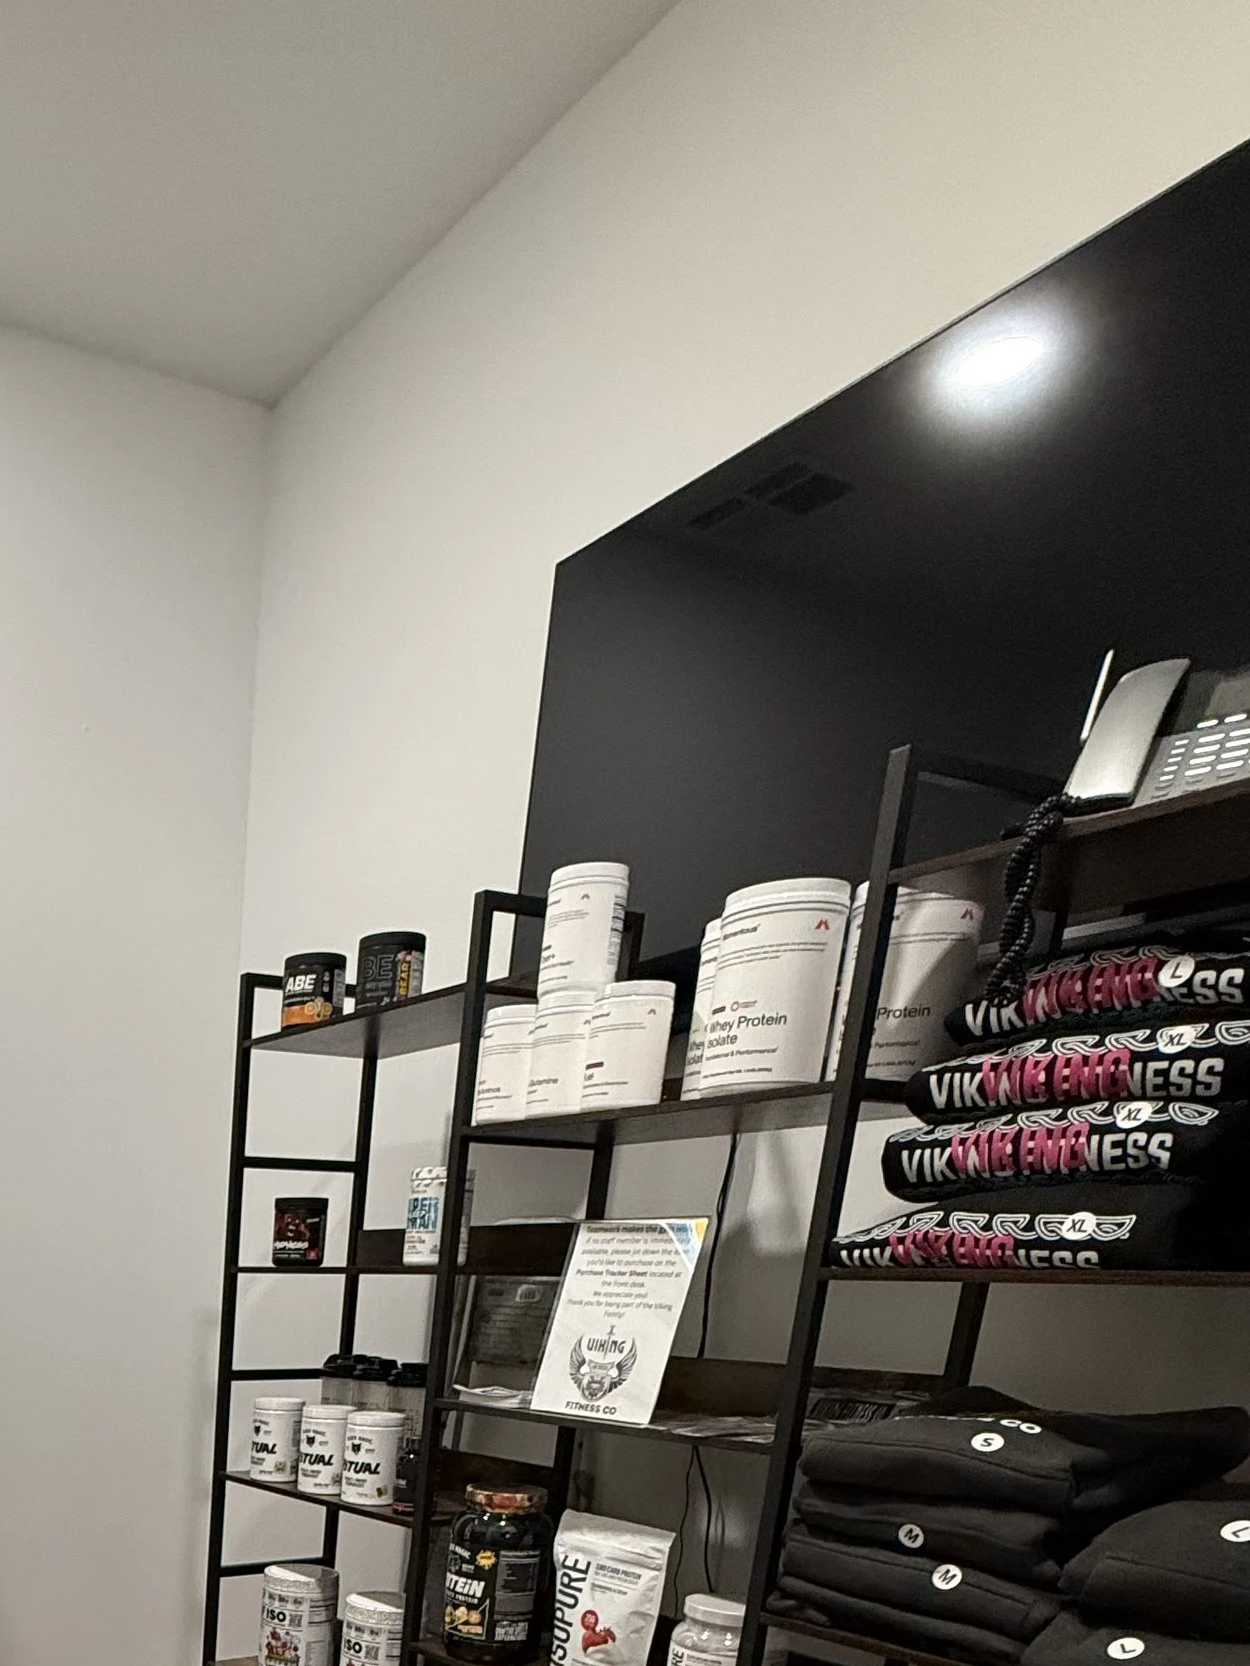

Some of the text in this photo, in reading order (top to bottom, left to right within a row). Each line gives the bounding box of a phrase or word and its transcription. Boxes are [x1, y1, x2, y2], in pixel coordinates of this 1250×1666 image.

[1170, 962, 1183, 980] L
[285, 974, 317, 993] ABE
[736, 1011, 788, 1029] Protein
[876, 1005, 931, 1021] Protein
[1165, 1031, 1188, 1047] XL
[1121, 1107, 1143, 1123] XL
[1065, 1218, 1089, 1234] XL
[565, 1401, 617, 1415] FITNESS CO
[979, 1437, 994, 1447] S
[903, 1528, 920, 1544] M
[938, 1569, 957, 1586] M
[266, 1609, 287, 1623] ISO
[1120, 1643, 1136, 1655] L
